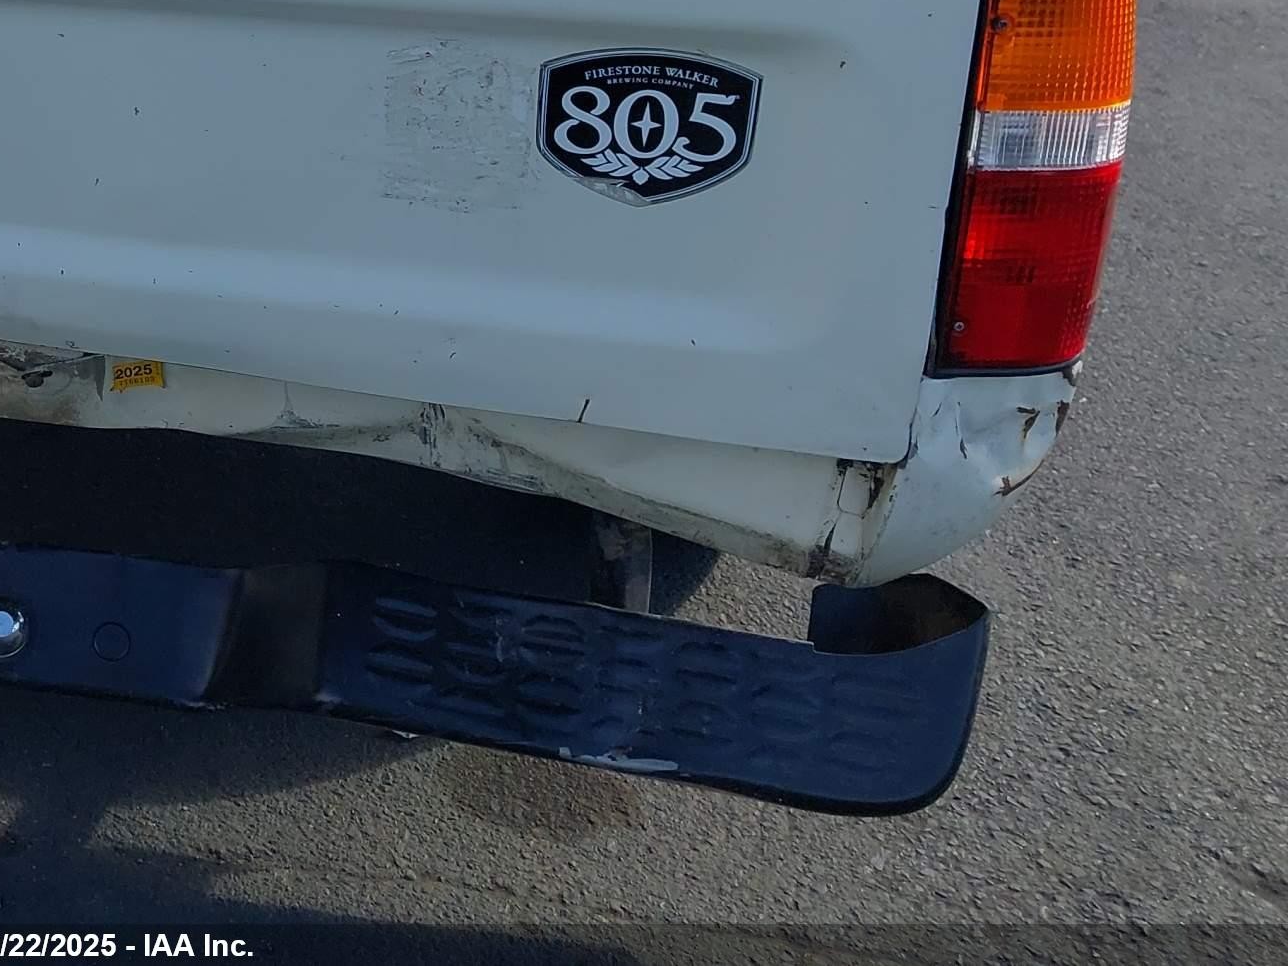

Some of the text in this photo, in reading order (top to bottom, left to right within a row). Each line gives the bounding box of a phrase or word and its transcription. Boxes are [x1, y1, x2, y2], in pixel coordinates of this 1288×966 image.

[584, 65, 720, 89] FIRESTONE WALKER
[606, 77, 695, 91] BREWING COMPANY
[553, 85, 738, 163] 805
[115, 364, 153, 380] 2025
